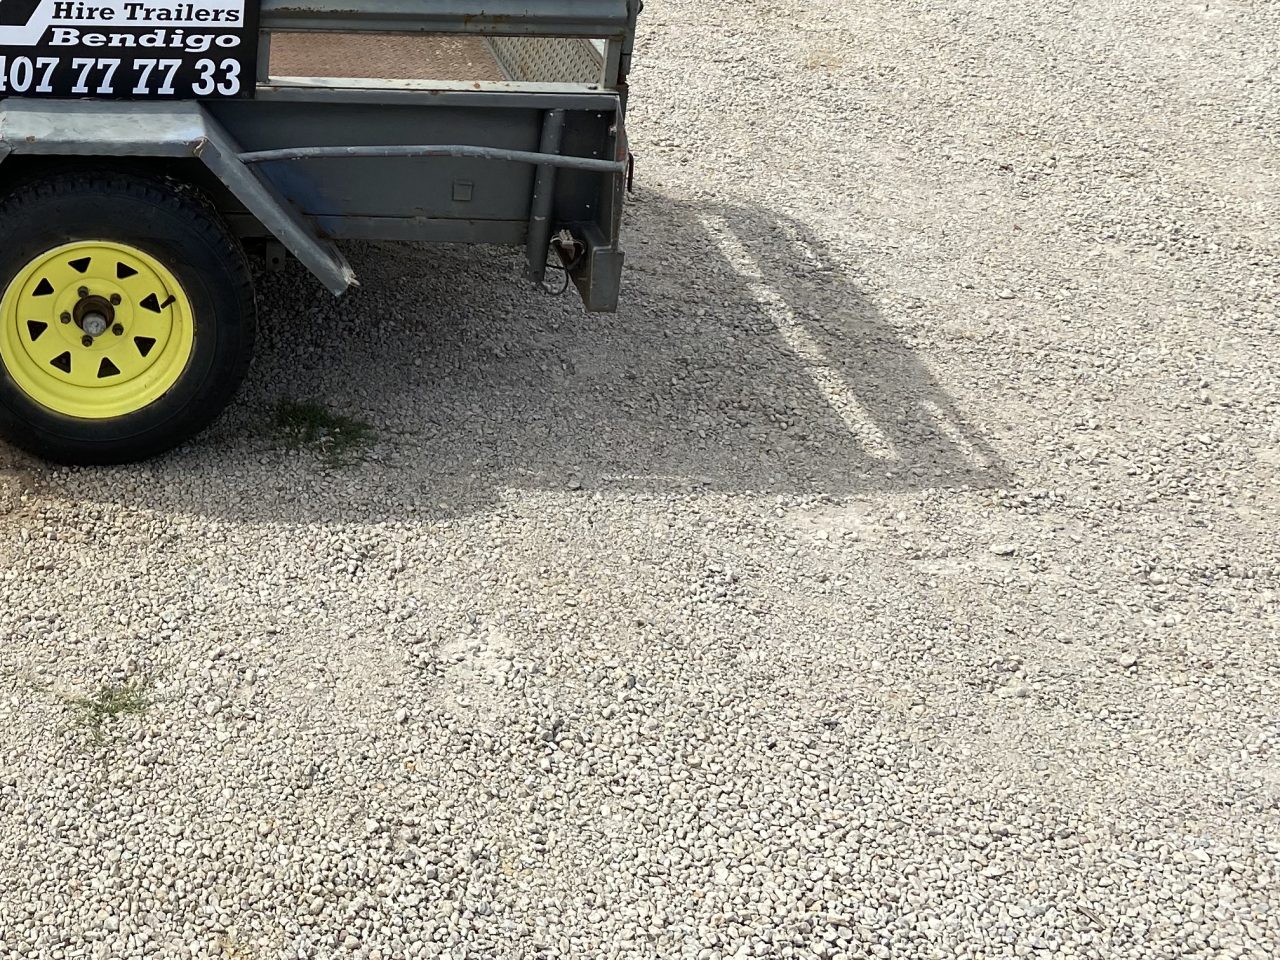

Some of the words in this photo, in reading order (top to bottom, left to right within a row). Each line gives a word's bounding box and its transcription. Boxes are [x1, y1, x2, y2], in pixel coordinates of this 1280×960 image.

[52, 1, 115, 20] Hire
[124, 3, 240, 22] Trailers
[48, 27, 241, 53] Bendigo
[71, 58, 121, 94] 77
[132, 59, 182, 95] 77
[191, 59, 241, 96] 33
